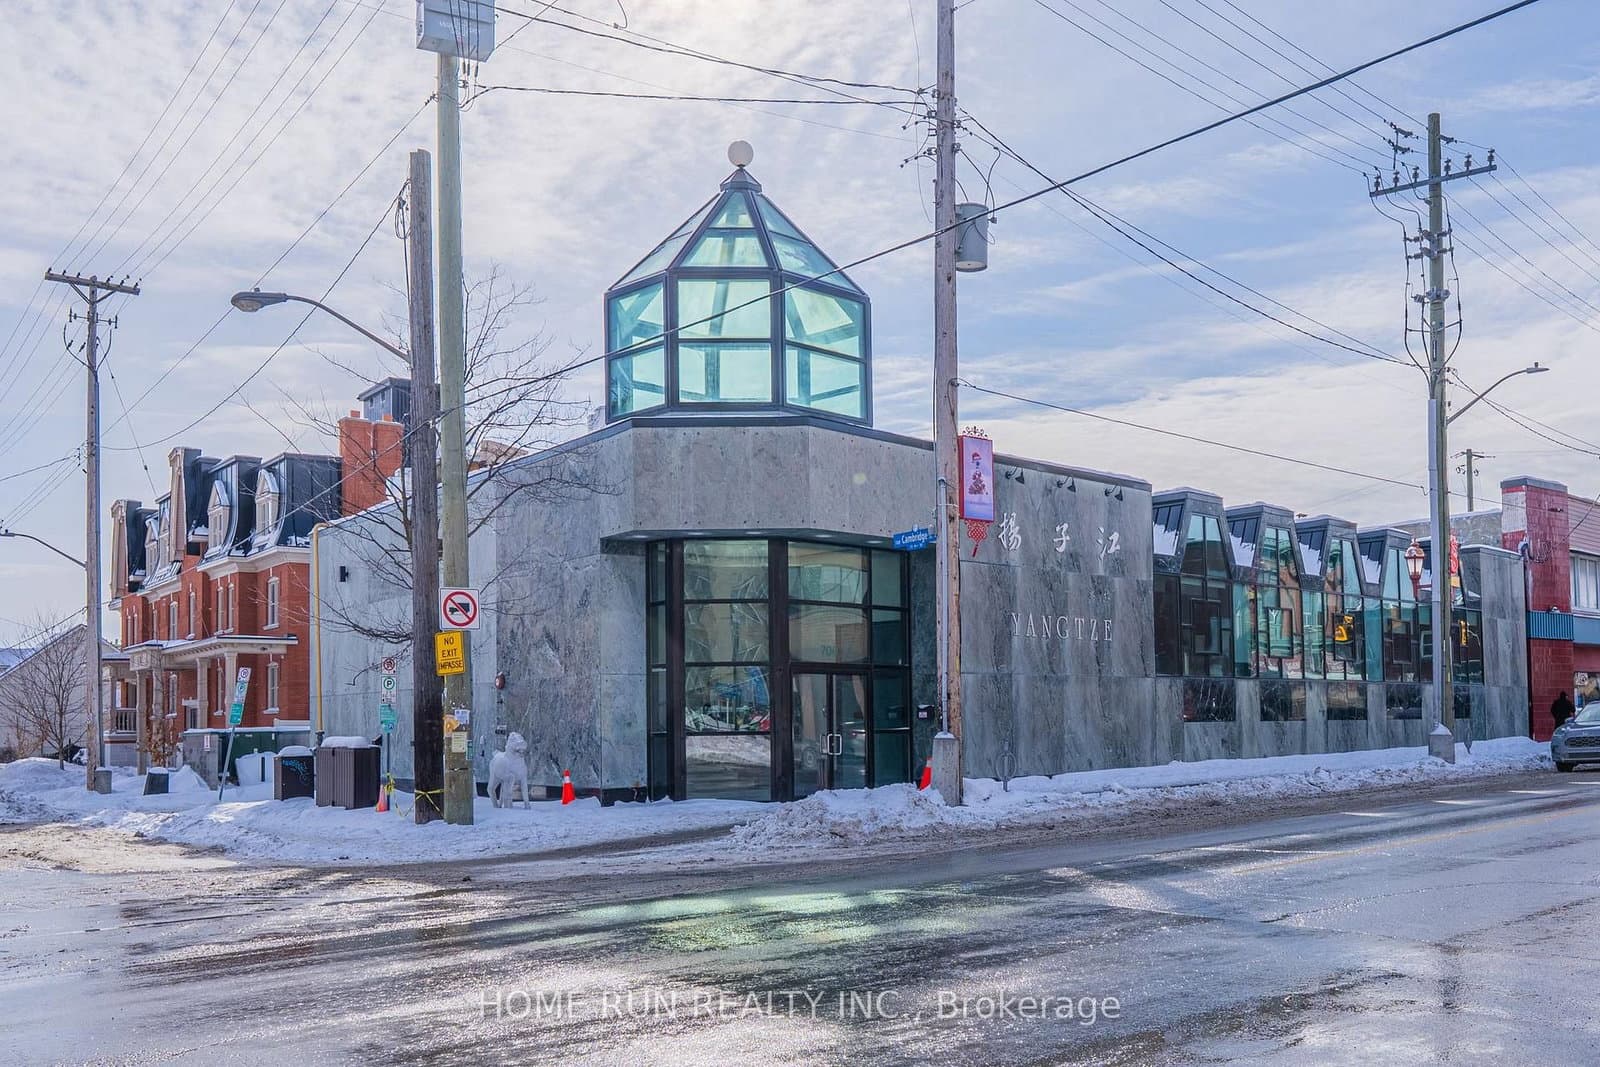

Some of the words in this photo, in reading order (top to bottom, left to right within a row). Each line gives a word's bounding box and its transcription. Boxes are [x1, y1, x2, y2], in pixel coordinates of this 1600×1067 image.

[901, 531, 928, 544] Cambridge
[1011, 612, 1113, 641] YANGTZE
[444, 637, 454, 645] NO
[442, 648, 457, 657] EXIT
[439, 660, 463, 669] IMPASSE
